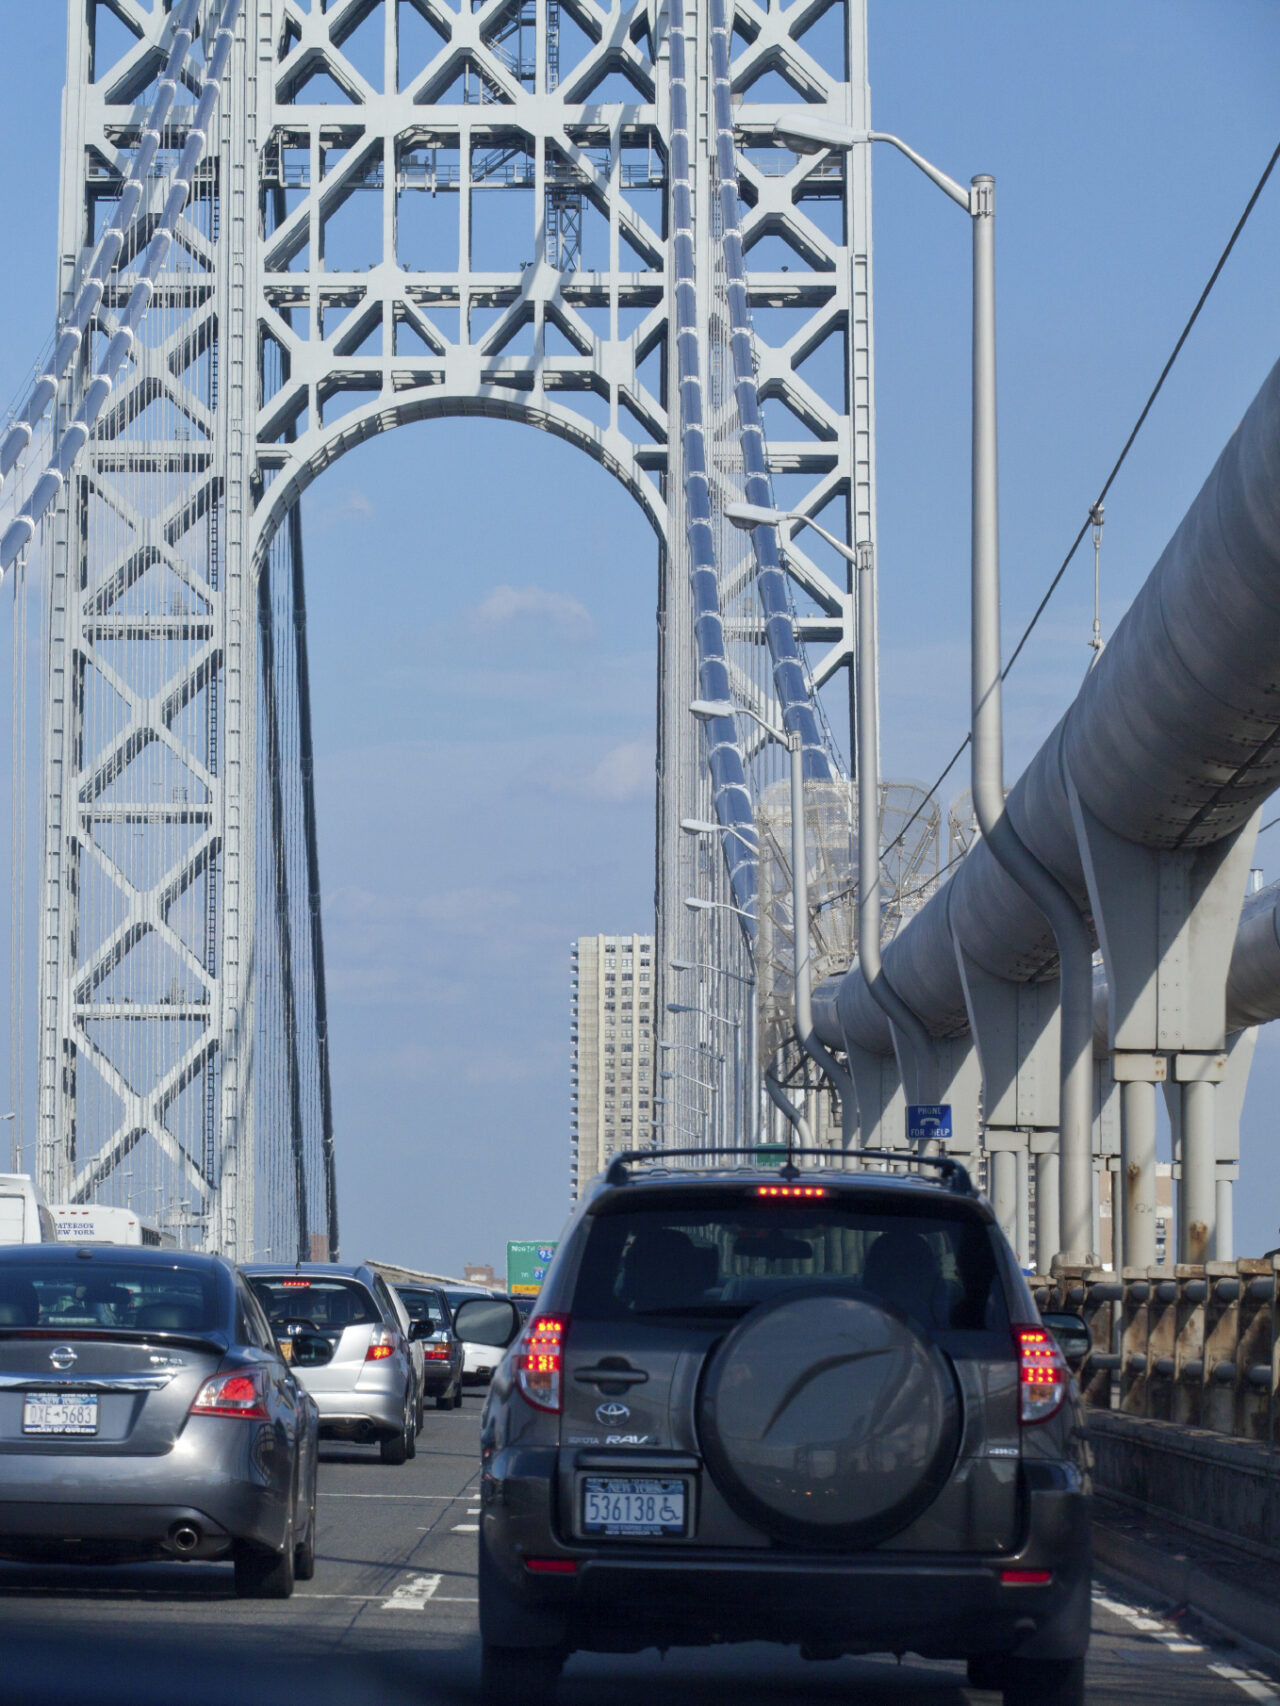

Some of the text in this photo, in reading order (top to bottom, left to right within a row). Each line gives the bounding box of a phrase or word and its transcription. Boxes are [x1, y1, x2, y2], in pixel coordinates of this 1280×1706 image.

[917, 1107, 942, 1115] PHONE
[910, 1128, 950, 1137] FOR HELP
[589, 1495, 656, 1522] 536138
